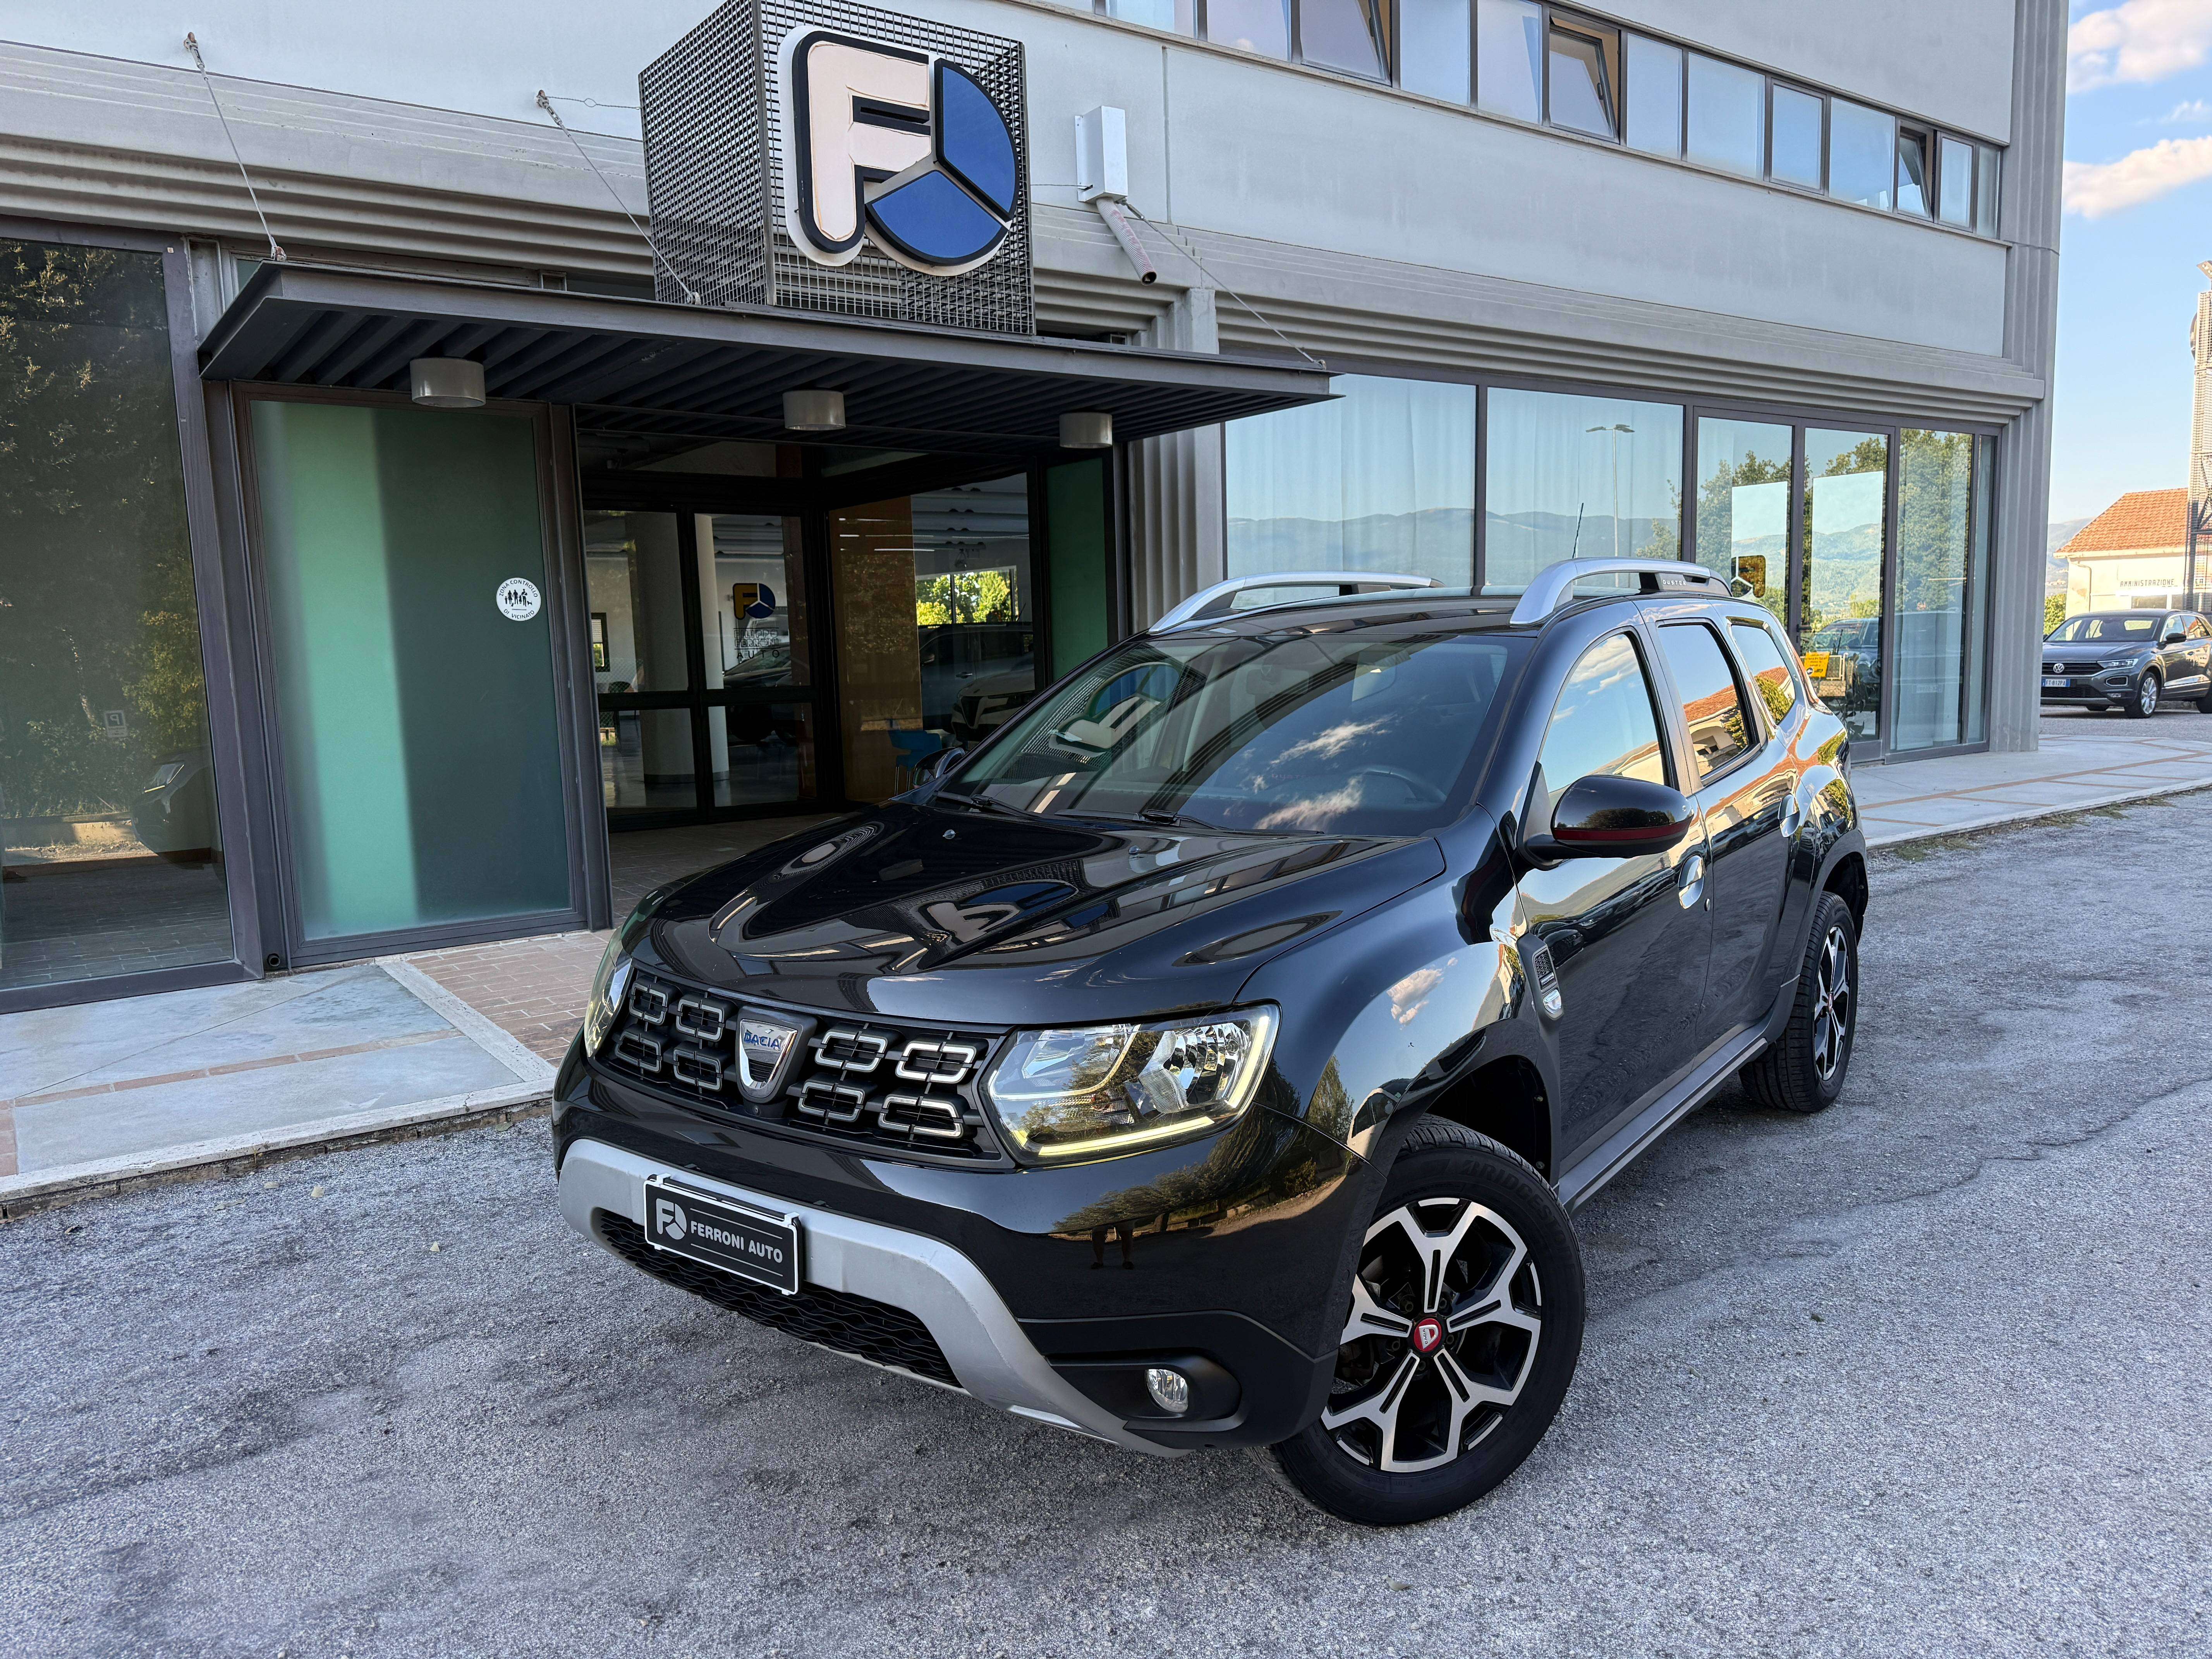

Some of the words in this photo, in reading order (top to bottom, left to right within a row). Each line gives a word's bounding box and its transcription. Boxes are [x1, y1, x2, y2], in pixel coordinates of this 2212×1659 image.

[499, 583, 509, 596] ZONA
[510, 580, 538, 597] CONTROLLO
[2120, 579, 2175, 587] AMMINISTRAZIONE
[512, 610, 534, 619] VICINATO
[737, 649, 780, 659] AUTO
[744, 1032, 781, 1050] DACIA
[690, 1221, 744, 1250] FERRONI
[749, 1240, 783, 1263] AUTO
